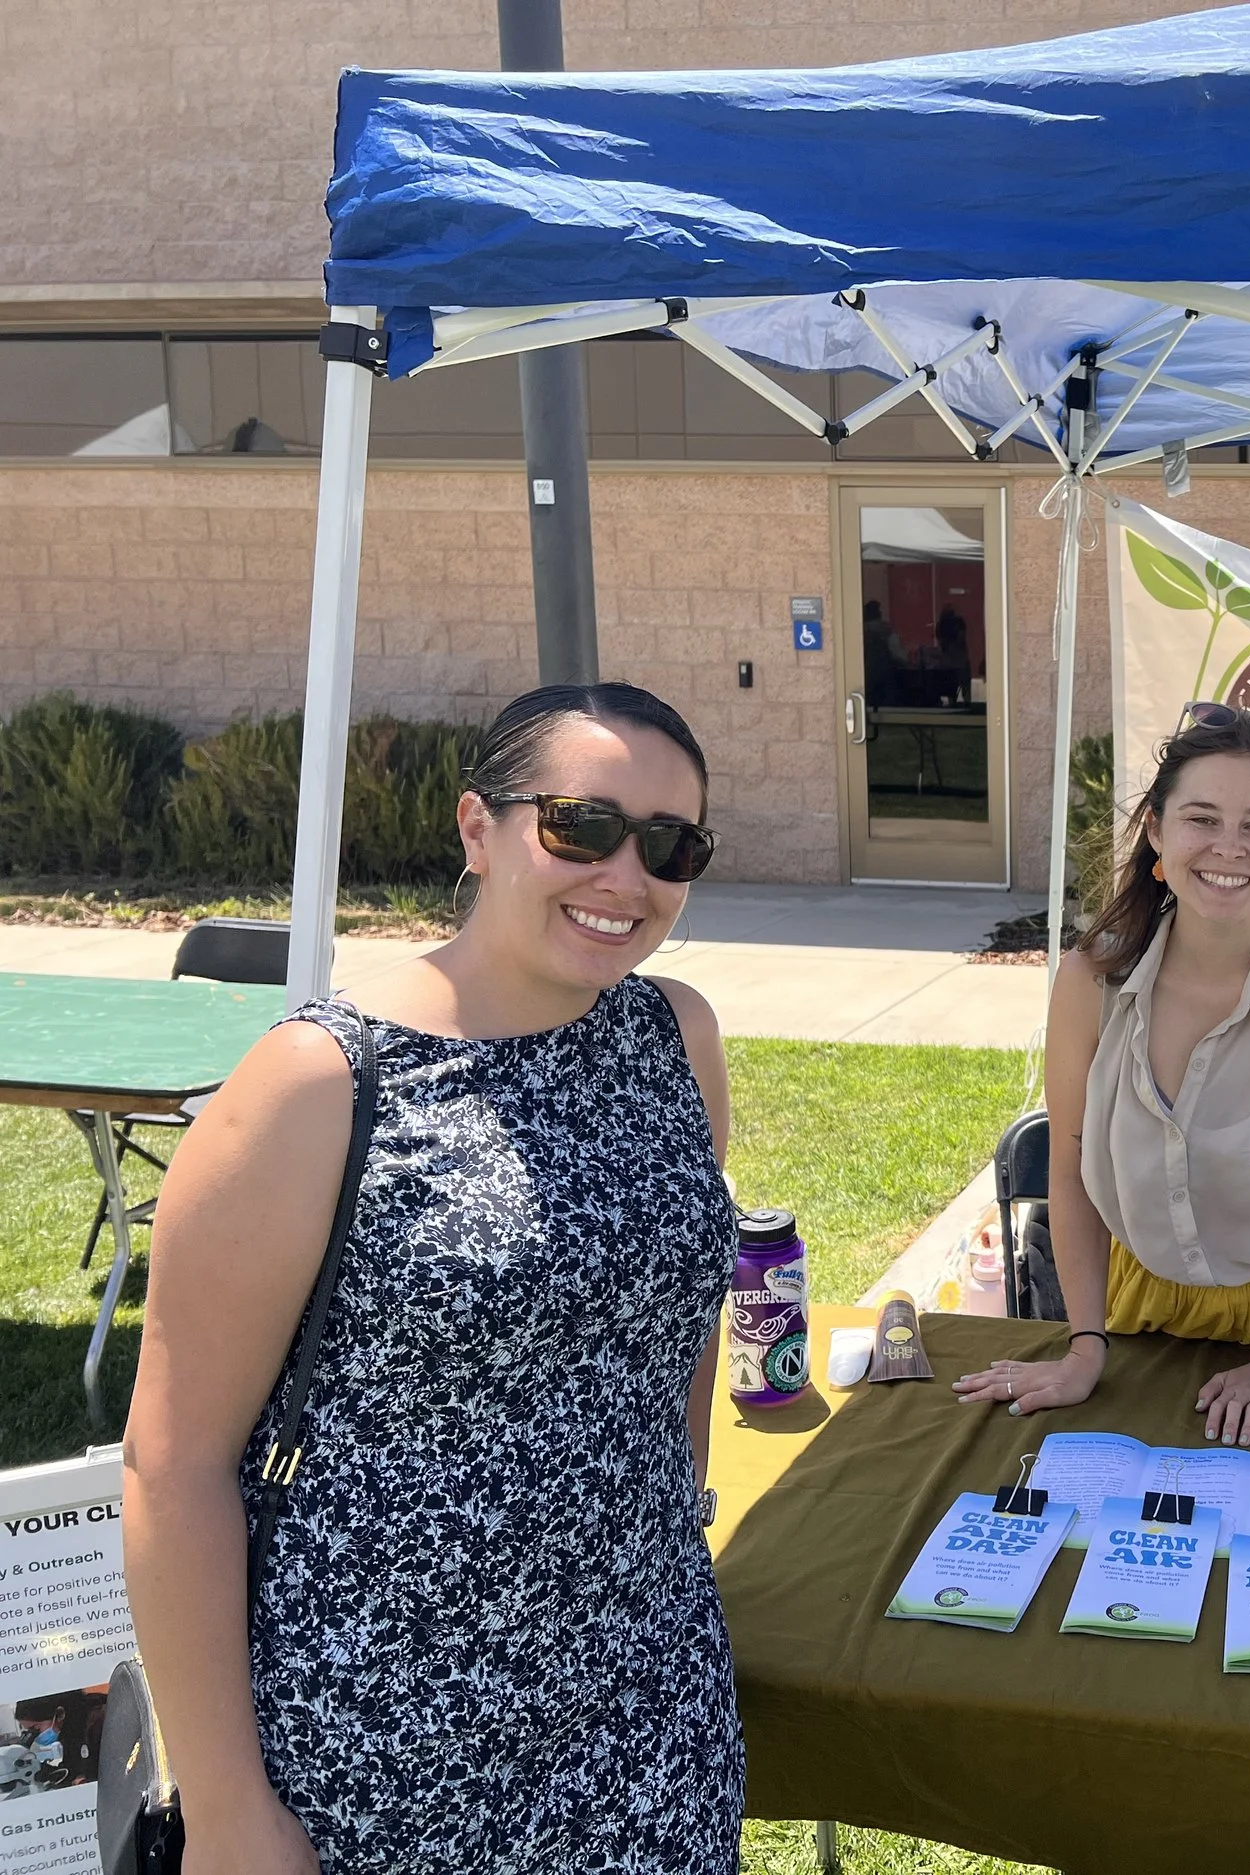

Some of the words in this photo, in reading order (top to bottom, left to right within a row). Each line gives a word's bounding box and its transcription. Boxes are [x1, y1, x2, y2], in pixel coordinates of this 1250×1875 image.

[5, 1510, 79, 1537] YOUR
[86, 1503, 122, 1523] CL
[962, 1512, 1050, 1534] CLEAN
[944, 1536, 1031, 1557] DAY
[952, 1524, 1038, 1546] AIR
[1109, 1530, 1199, 1553] CLEAN
[12, 1564, 24, 1575] &
[28, 1550, 104, 1573] Outreach
[1104, 1547, 1193, 1570] AIR
[24, 1586, 43, 1598] for
[47, 1575, 101, 1595] positive
[26, 1606, 34, 1615] a
[38, 1597, 74, 1612] fossil
[35, 1617, 84, 1634] justice.
[87, 1609, 109, 1622] We
[31, 1634, 78, 1649] voices,
[81, 1621, 134, 1643] especia
[0, 1659, 33, 1675] eard
[37, 1658, 49, 1668] in
[52, 1653, 74, 1665] the
[77, 1640, 138, 1659] decision-
[1, 1823, 32, 1837] Gas
[49, 1841, 57, 1850] a
[60, 1831, 99, 1847] future
[12, 1850, 96, 1875] accountable
